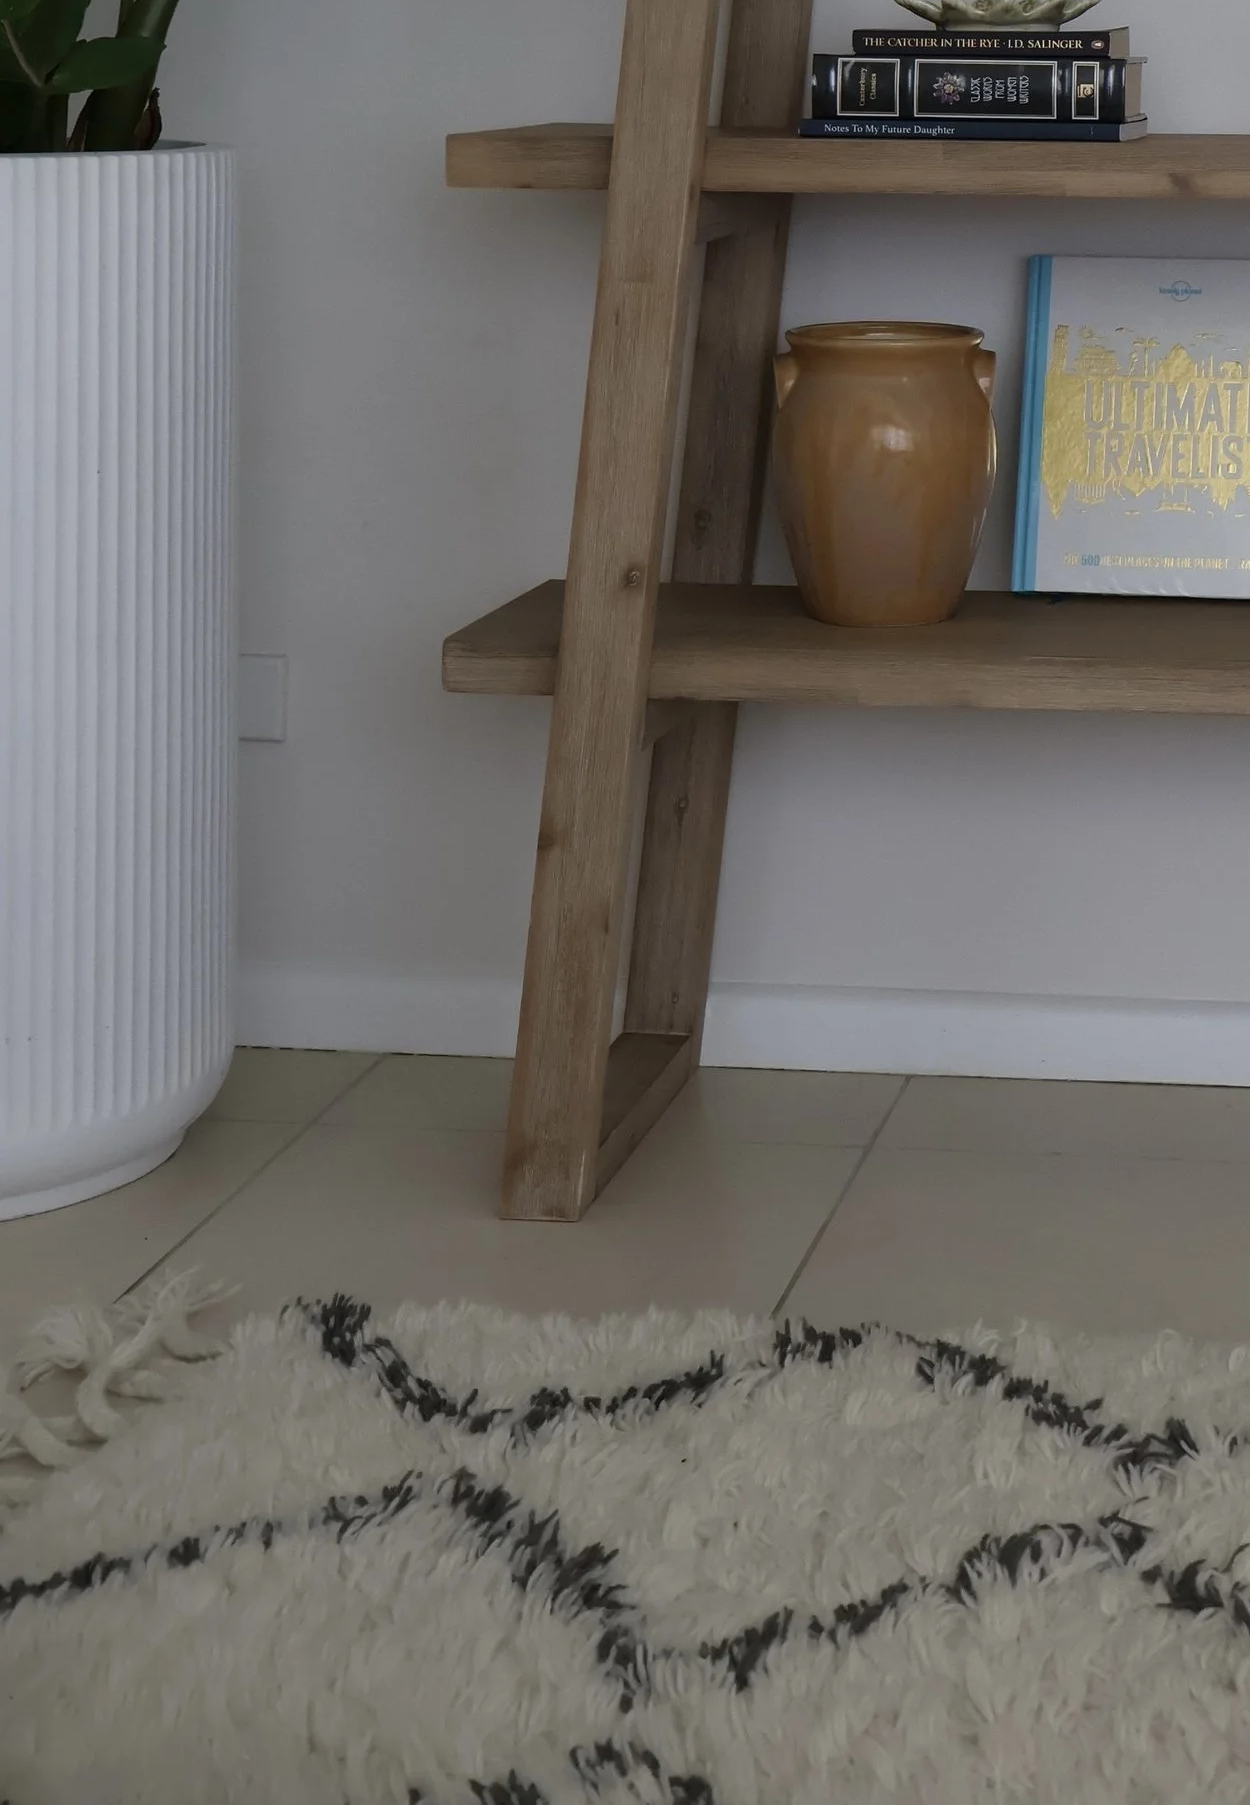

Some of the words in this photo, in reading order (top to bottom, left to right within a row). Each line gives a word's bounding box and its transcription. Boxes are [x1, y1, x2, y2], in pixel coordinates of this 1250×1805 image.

[863, 37, 885, 47] THE
[887, 37, 938, 47] CATCHER
[940, 38, 952, 47] IN
[954, 38, 977, 48] THE
[979, 39, 1000, 48] RYE
[1027, 39, 1083, 49] SALINGER
[995, 79, 1005, 99] FROM
[824, 124, 849, 133] Notes
[852, 124, 863, 133] To
[865, 124, 879, 135] My
[882, 125, 911, 134] Future
[913, 125, 955, 136] Daughter
[1195, 557, 1229, 569] PLANET
